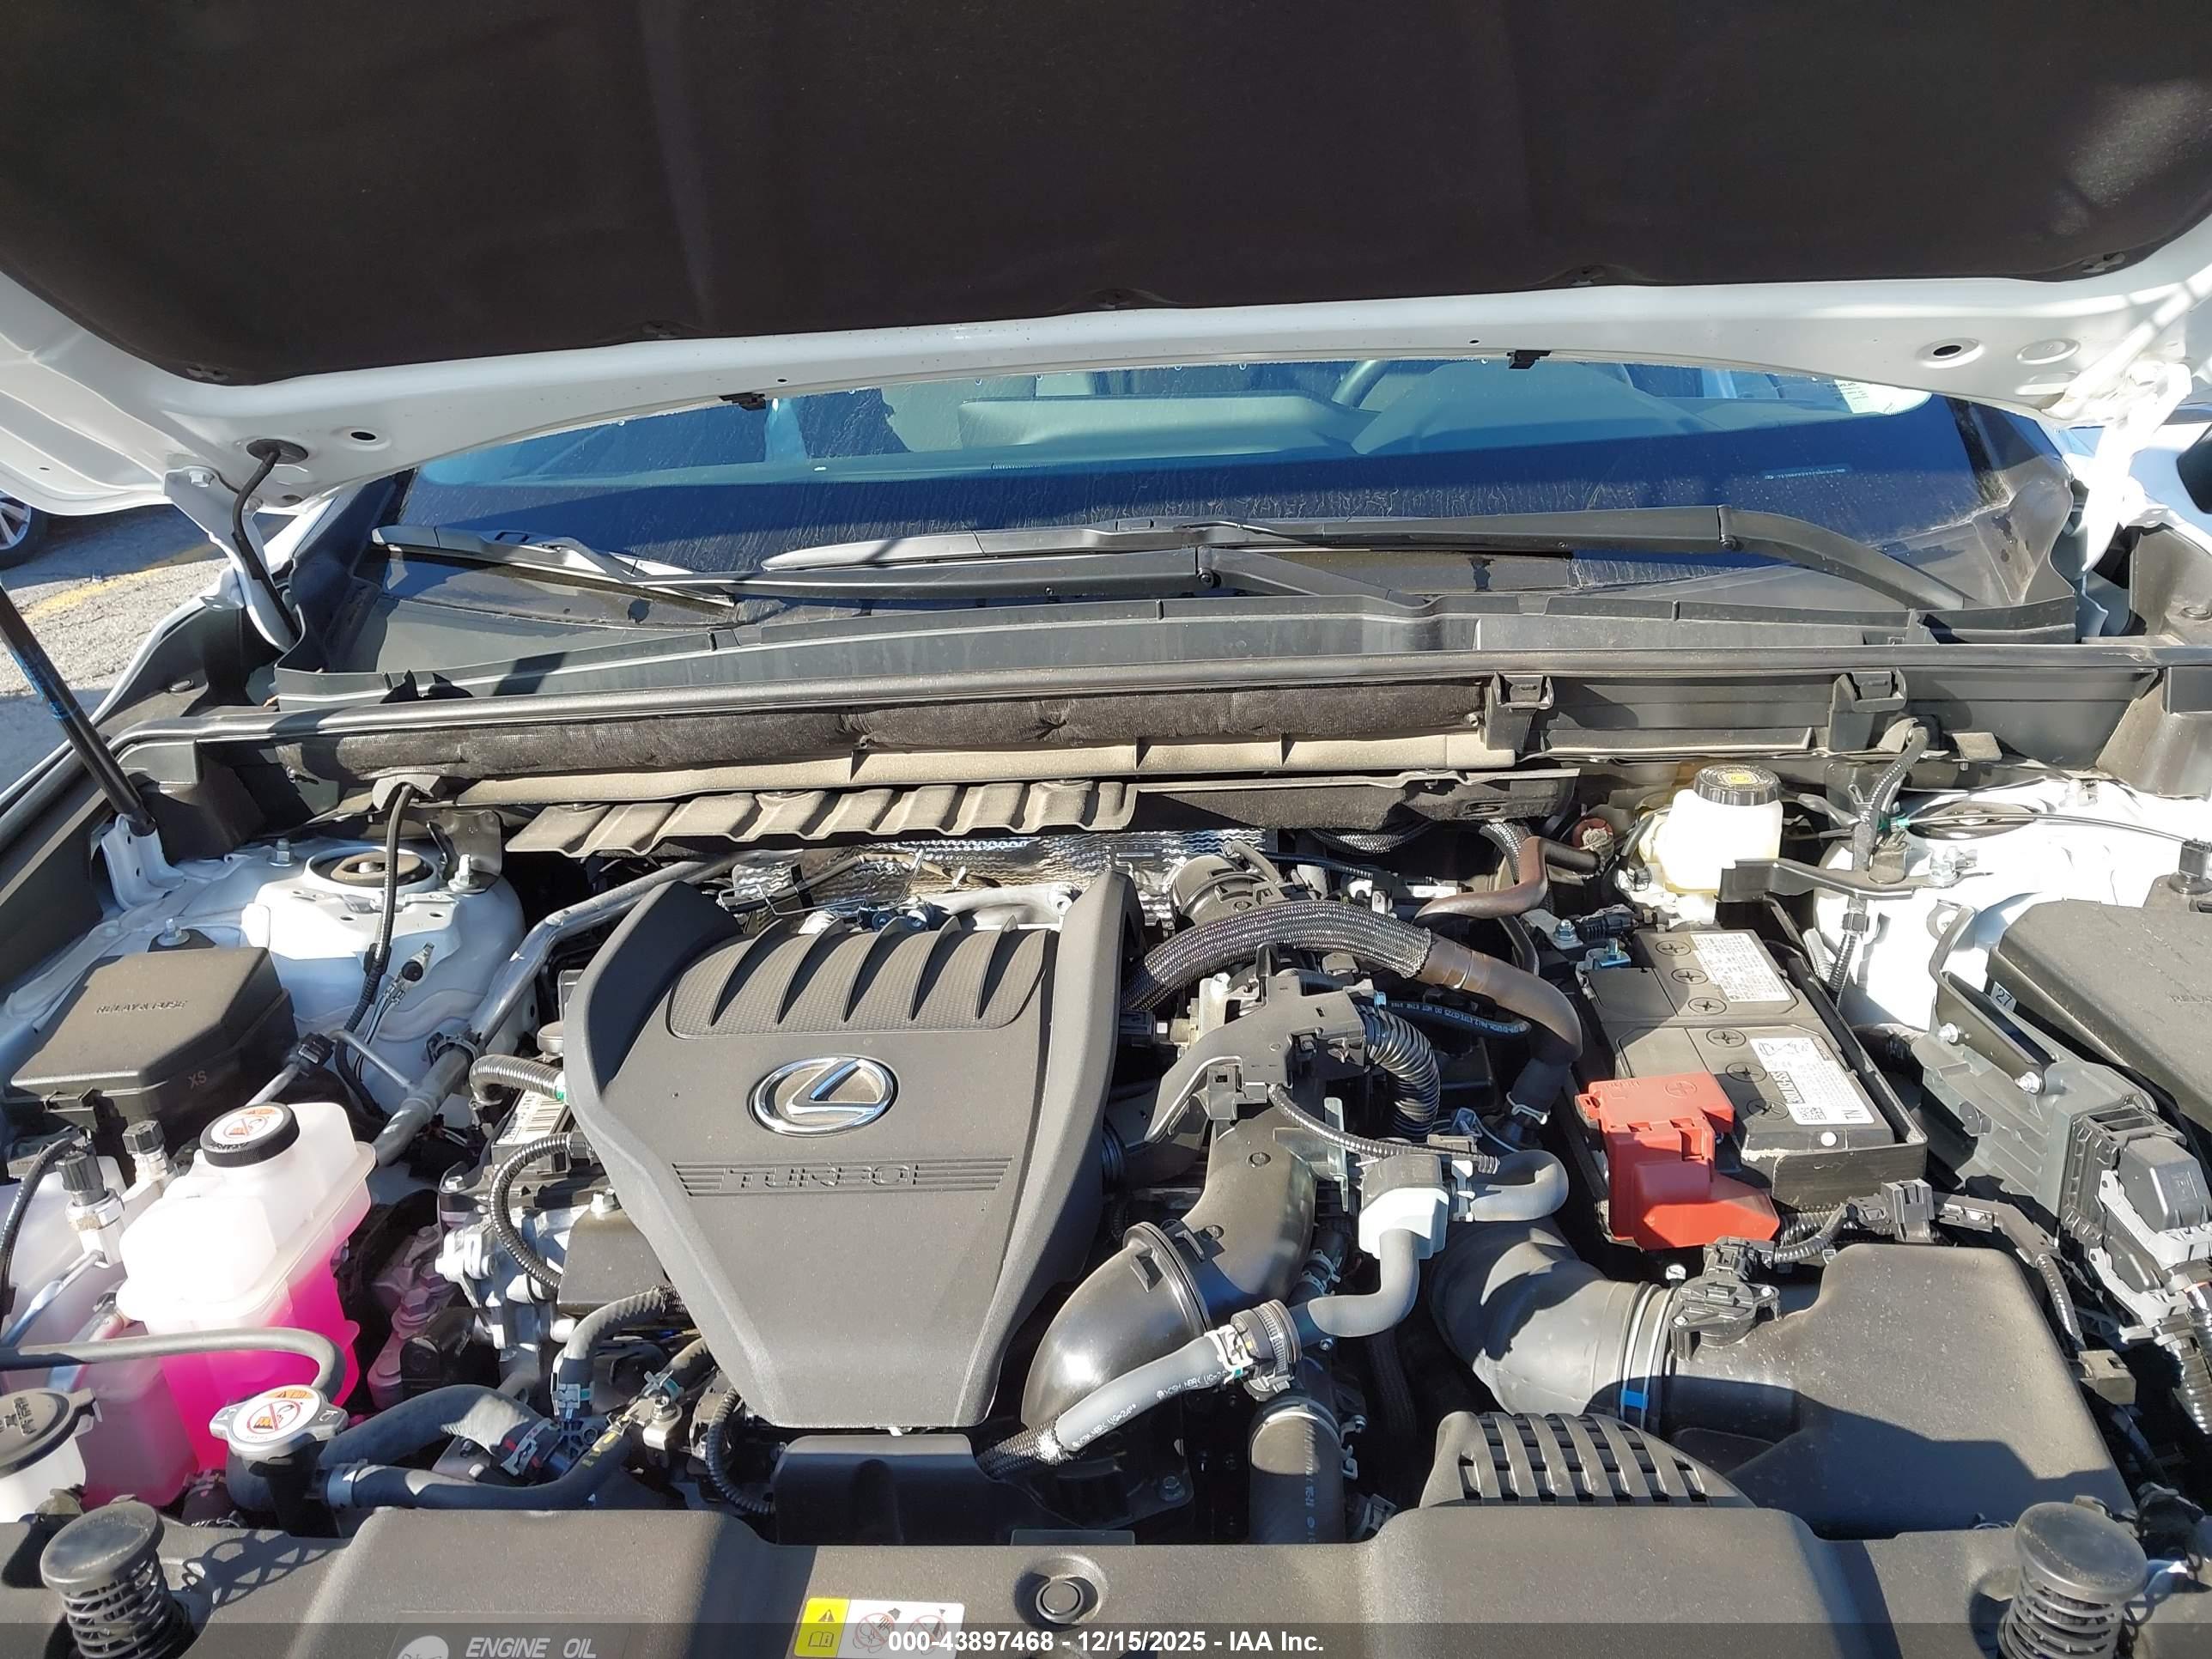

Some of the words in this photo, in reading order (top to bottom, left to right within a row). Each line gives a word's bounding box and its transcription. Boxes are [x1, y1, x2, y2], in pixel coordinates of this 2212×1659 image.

[1996, 988, 2013, 1006] 27
[187, 1070, 207, 1090] XS
[729, 1164, 910, 1188] TURBO
[465, 1637, 550, 1659] ENGINE
[562, 1638, 598, 1659] OIL
